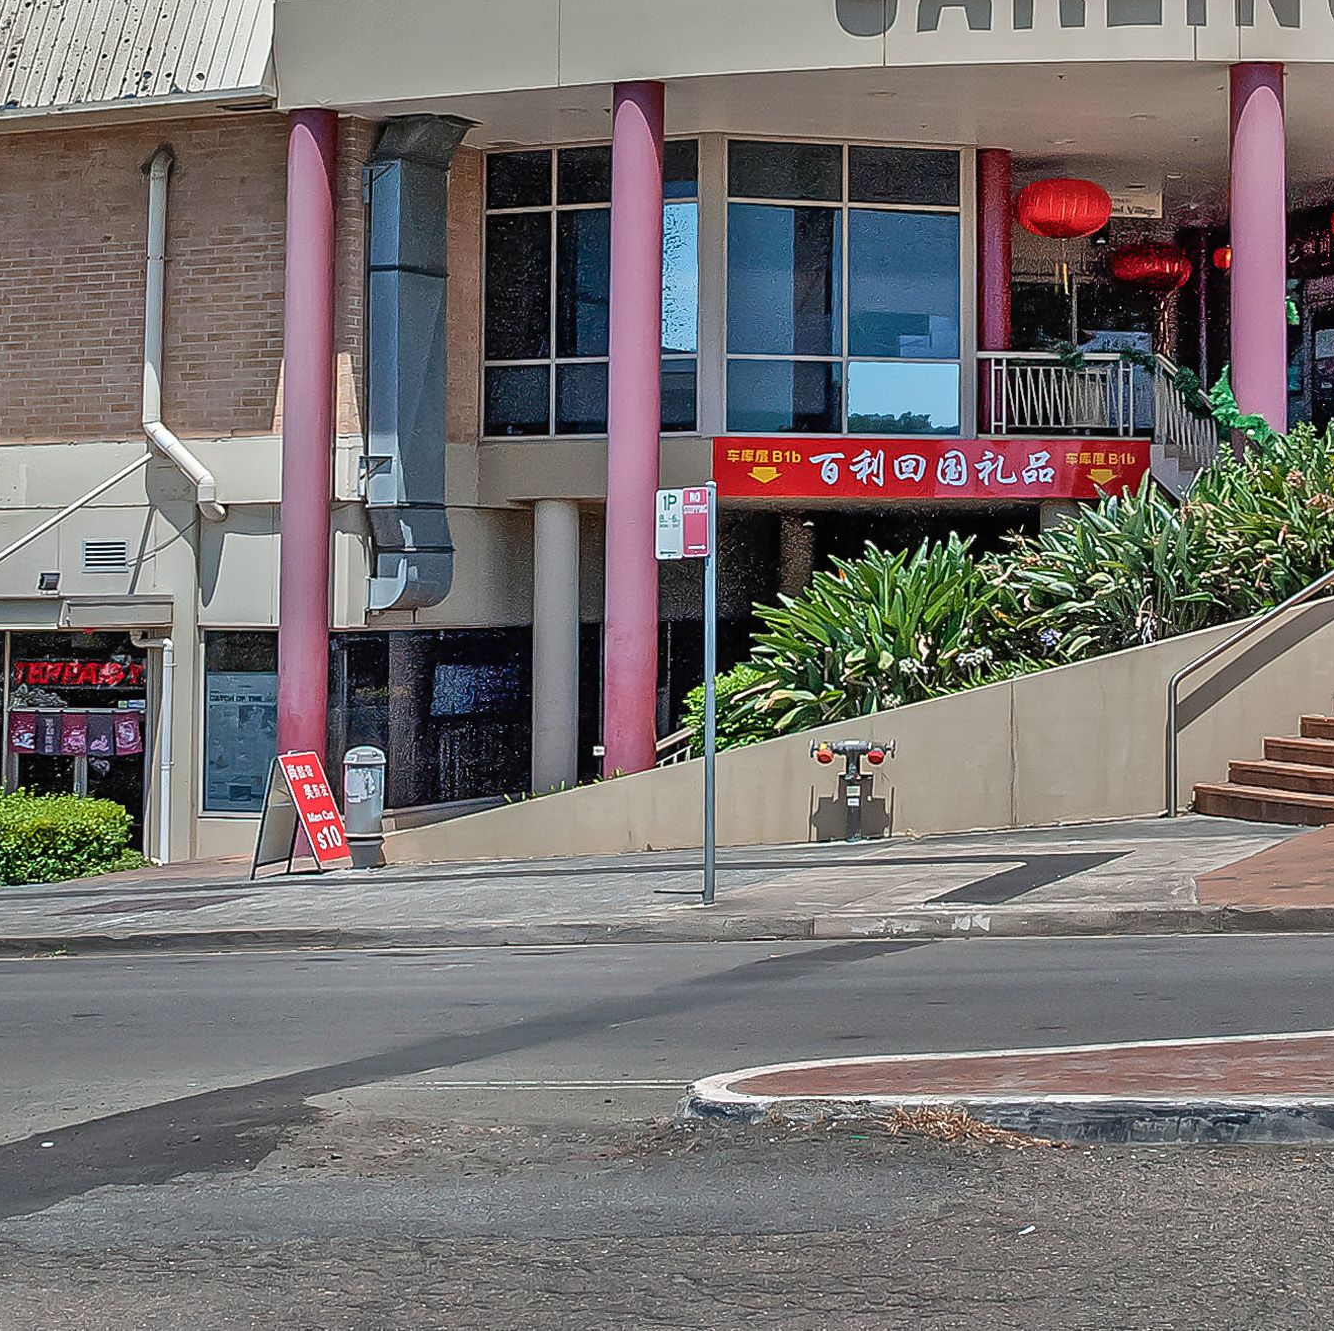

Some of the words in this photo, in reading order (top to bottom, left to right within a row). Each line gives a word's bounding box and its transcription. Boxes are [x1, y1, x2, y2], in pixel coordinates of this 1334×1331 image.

[772, 450, 801, 463] B1b
[1109, 452, 1136, 465] B1b
[809, 448, 1056, 488] 百利回国礼品
[663, 494, 677, 511] 1P
[316, 825, 342, 850] $10
